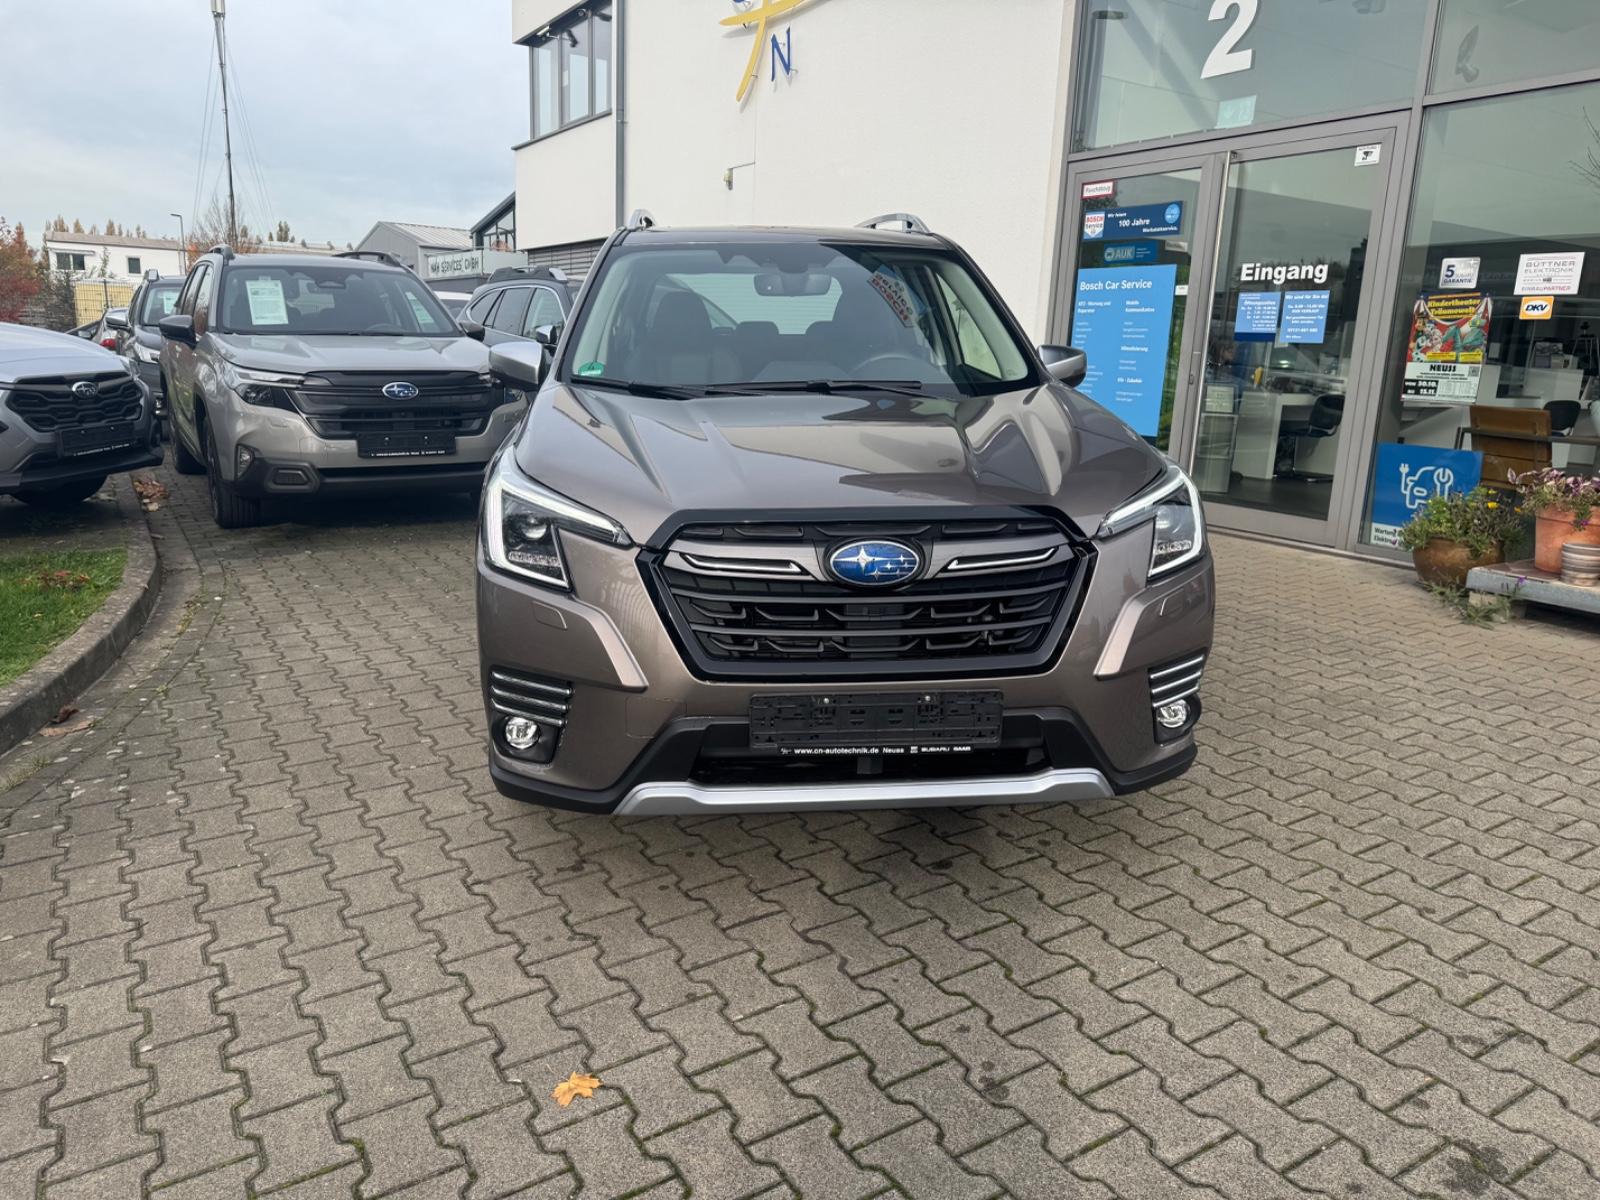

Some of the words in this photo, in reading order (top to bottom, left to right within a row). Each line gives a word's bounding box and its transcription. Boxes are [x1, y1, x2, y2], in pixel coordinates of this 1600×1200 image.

[1201, 0, 1257, 79] 2
[1240, 263, 1329, 284] Eingang
[1445, 264, 1456, 278] 5
[1079, 280, 1103, 291] Bosch
[1105, 280, 1120, 290] Car
[1121, 279, 1153, 289] Service
[1429, 364, 1456, 372] NEUSS
